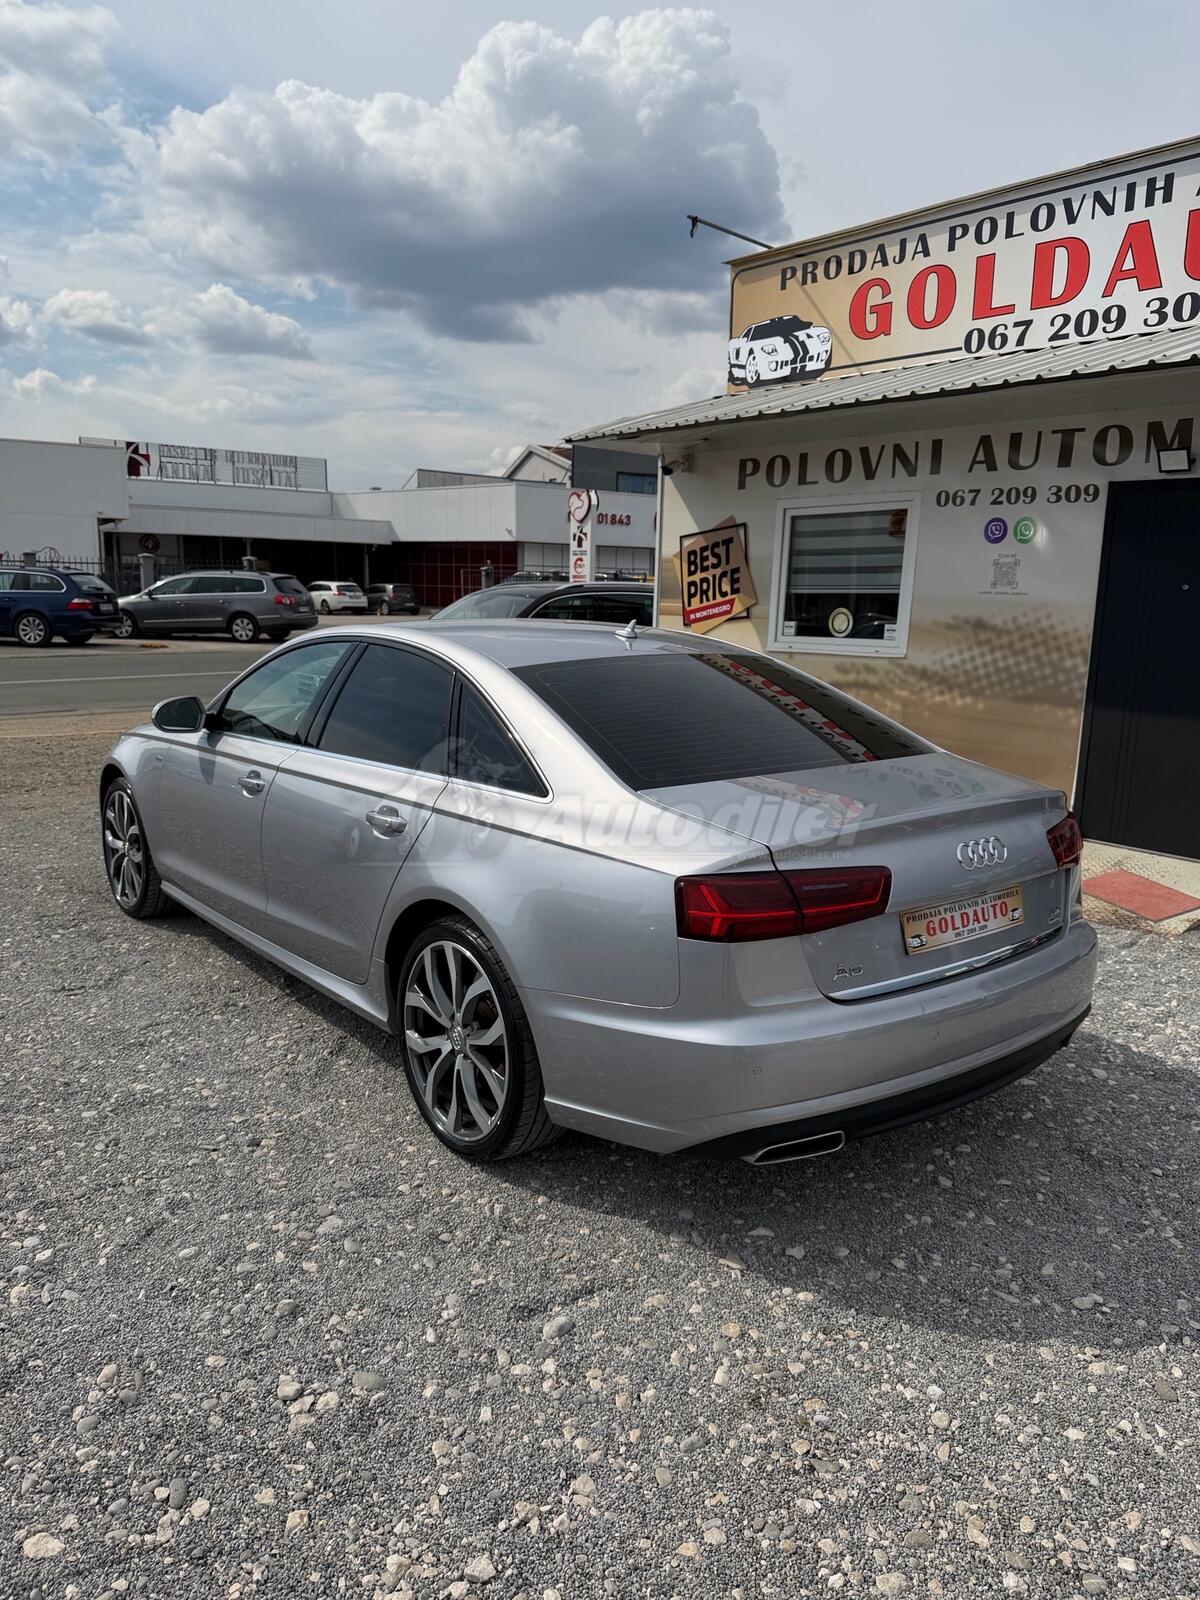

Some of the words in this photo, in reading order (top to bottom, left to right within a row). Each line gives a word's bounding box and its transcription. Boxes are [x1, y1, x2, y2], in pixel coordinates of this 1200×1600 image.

[780, 233, 932, 291] PRODAJA
[947, 172, 1175, 253] POLOVNIH
[963, 319, 1034, 354] 067
[1049, 304, 1127, 343] 209
[737, 438, 943, 490] POLOVNI
[935, 488, 980, 508] 067
[990, 486, 1037, 506] 209
[1047, 483, 1100, 505] 309
[687, 537, 734, 578] BEST
[687, 566, 741, 607] PRICE
[690, 612, 696, 620] IN
[696, 604, 731, 619] MONTENEGRO
[906, 909, 942, 924] PRODAJA
[944, 899, 980, 915] POLOVNIH
[980, 889, 1020, 905] AUTOMOBILA
[926, 901, 1009, 937] GOLDAUTO
[954, 930, 965, 938] 067
[966, 928, 977, 936] 209
[978, 924, 988, 933] 309
